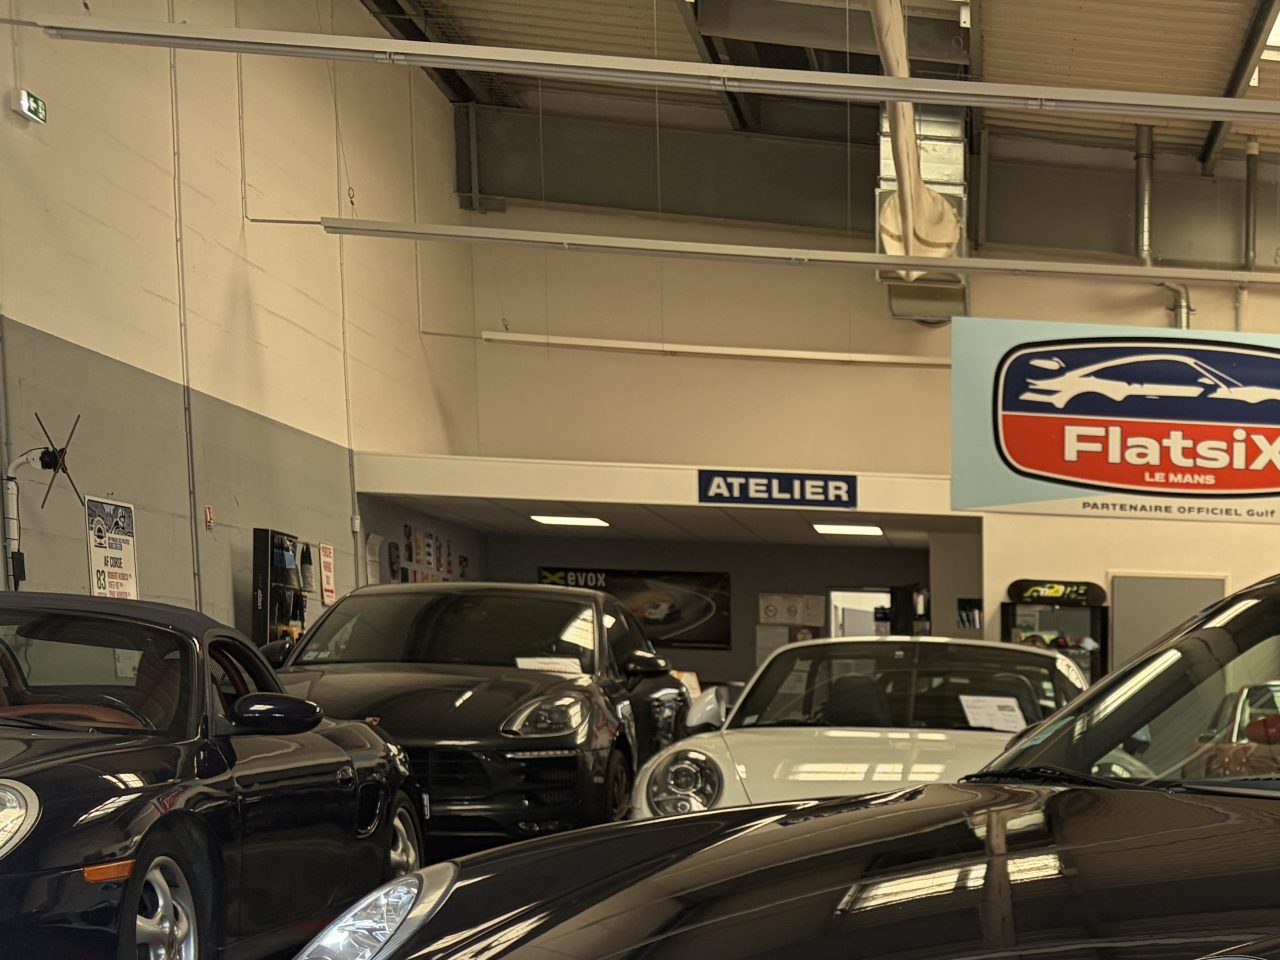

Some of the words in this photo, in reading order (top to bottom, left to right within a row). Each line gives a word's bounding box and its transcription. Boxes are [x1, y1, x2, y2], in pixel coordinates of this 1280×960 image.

[1144, 471, 1166, 483] LE
[1168, 472, 1216, 485] MANS
[708, 477, 849, 502] ATELIER
[1082, 501, 1173, 514] PARTENAIRE
[1177, 505, 1242, 517] OFFICIEL
[1246, 508, 1276, 518] Gulf
[96, 569, 107, 590] 83
[567, 571, 606, 587] evox
